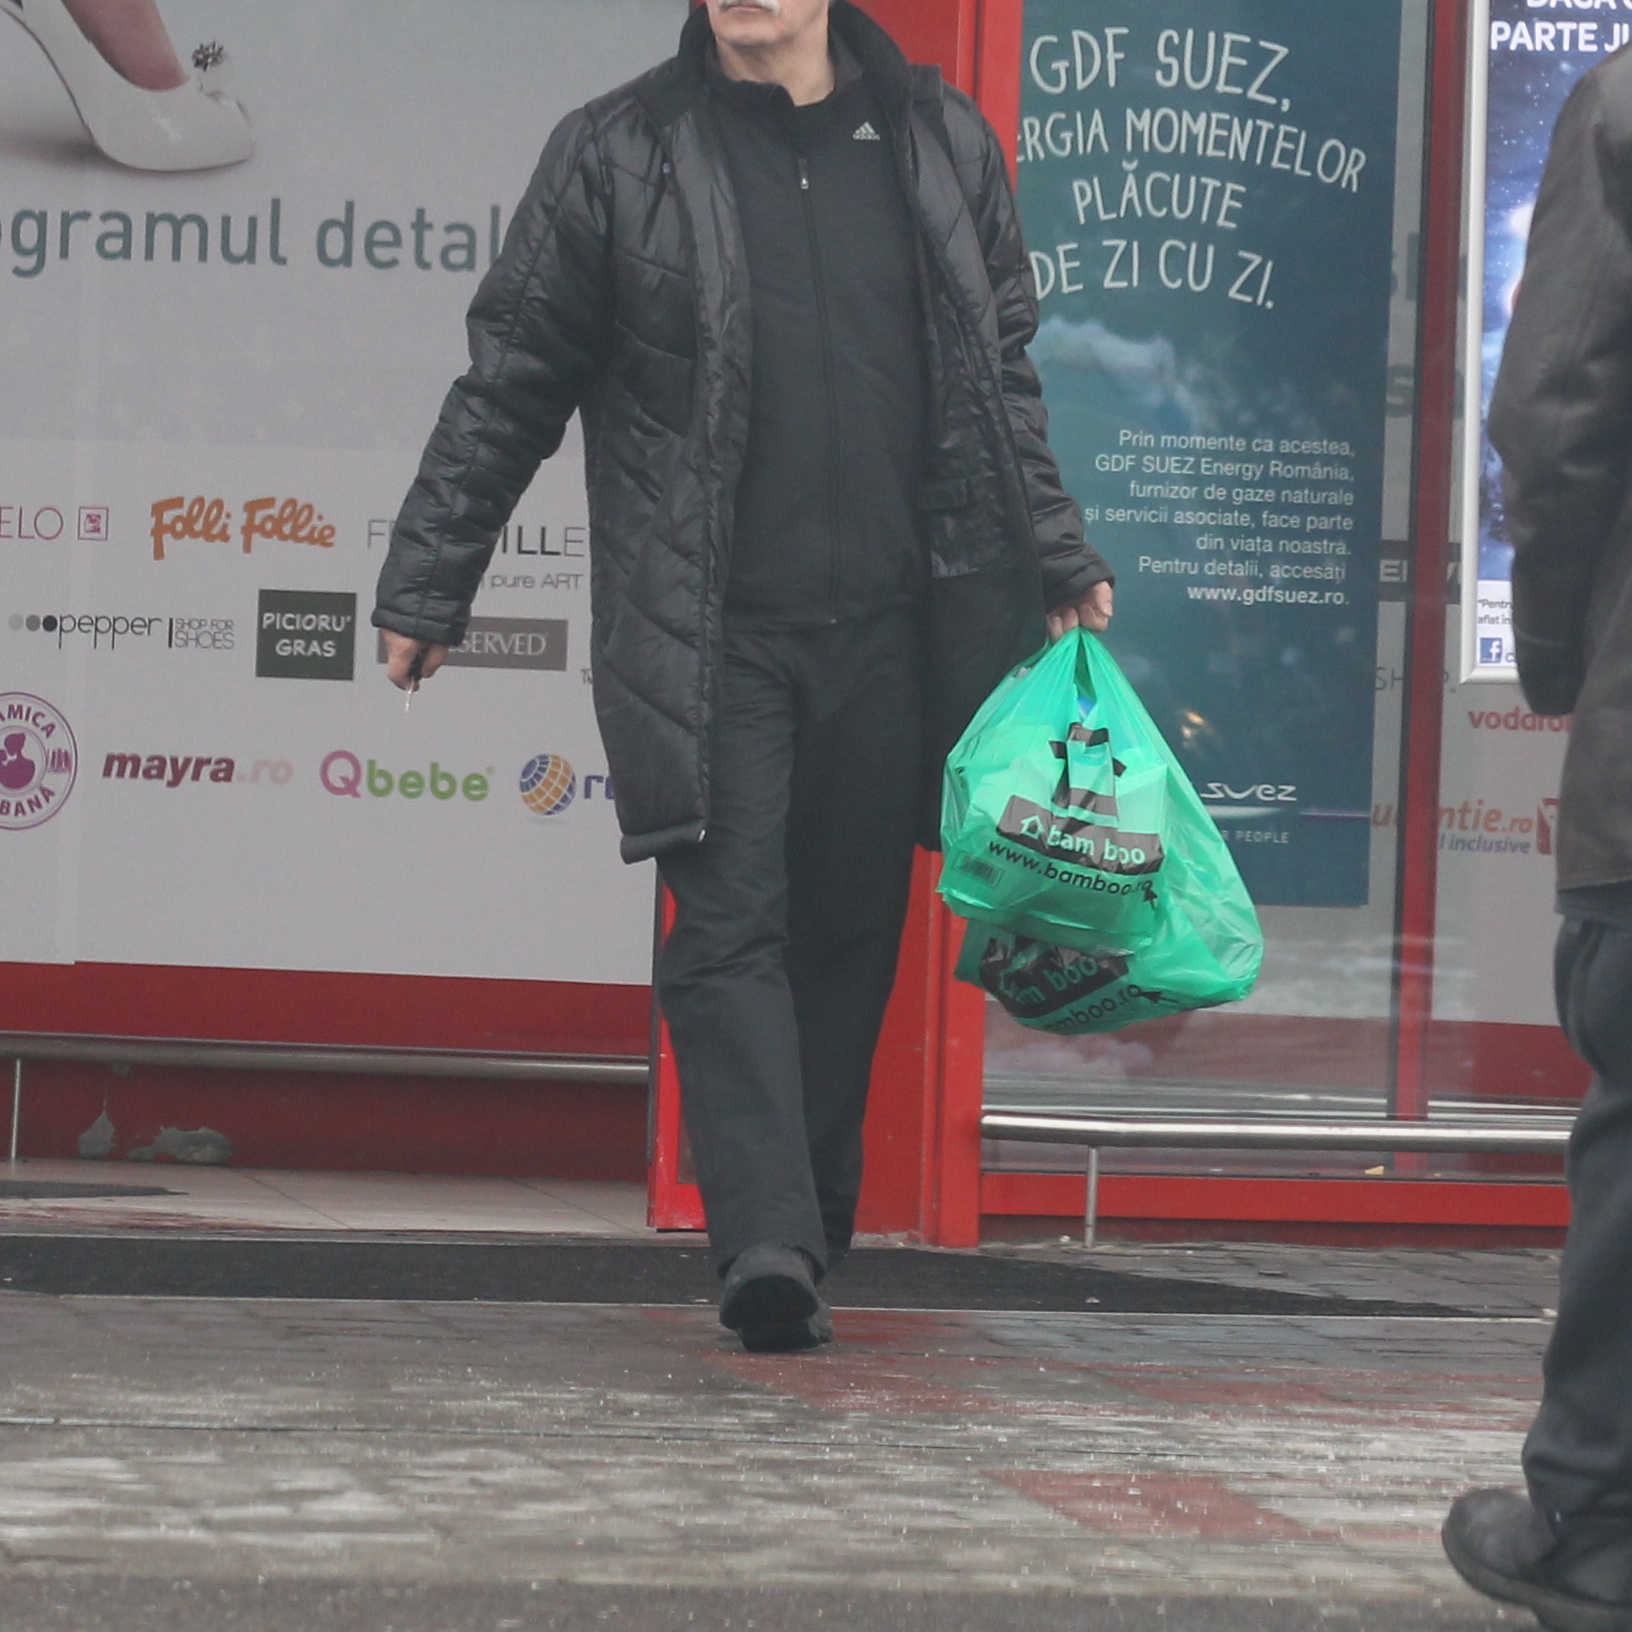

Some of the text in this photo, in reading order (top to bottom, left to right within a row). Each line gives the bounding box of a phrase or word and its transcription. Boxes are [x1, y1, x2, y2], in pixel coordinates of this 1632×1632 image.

[1491, 20, 1599, 53] PARTE
[1030, 26, 1290, 112] GDF SUEZ,
[1125, 106, 1367, 193] MOMENTELOR
[1072, 159, 1247, 229] PLĂCUTE
[315, 199, 503, 272] detal
[1029, 239, 1274, 310] DE ZI CU ZI.
[1119, 429, 1356, 458] Prin momente ca acestea,
[1095, 454, 1355, 482] GDF SUEZ Energy România,
[1129, 480, 1354, 506] furnizor de gaze naturale
[150, 496, 337, 560] Folli Follie
[1085, 504, 1353, 532] și servicii asociate, face parte
[1196, 534, 1225, 551] din
[1138, 555, 1199, 575] Pentru
[1204, 557, 1264, 579] detalii,
[490, 573, 534, 591] pure
[540, 572, 584, 590] ART
[1187, 584, 1351, 606] www.gdfsuez.ro.
[58, 613, 163, 651] pepper
[175, 617, 235, 633] SHOP FOR
[174, 630, 235, 651] SHOES
[275, 641, 337, 659] GRAS
[448, 629, 548, 657] SERVED
[102, 752, 294, 788] mayra.ro
[319, 749, 490, 801] Qbebe
[1046, 824, 1147, 866] bam boo
[1234, 830, 1289, 843] PEOPLE
[1448, 835, 1531, 854] inclusive
[988, 839, 1155, 896] www.bamboo.ro
